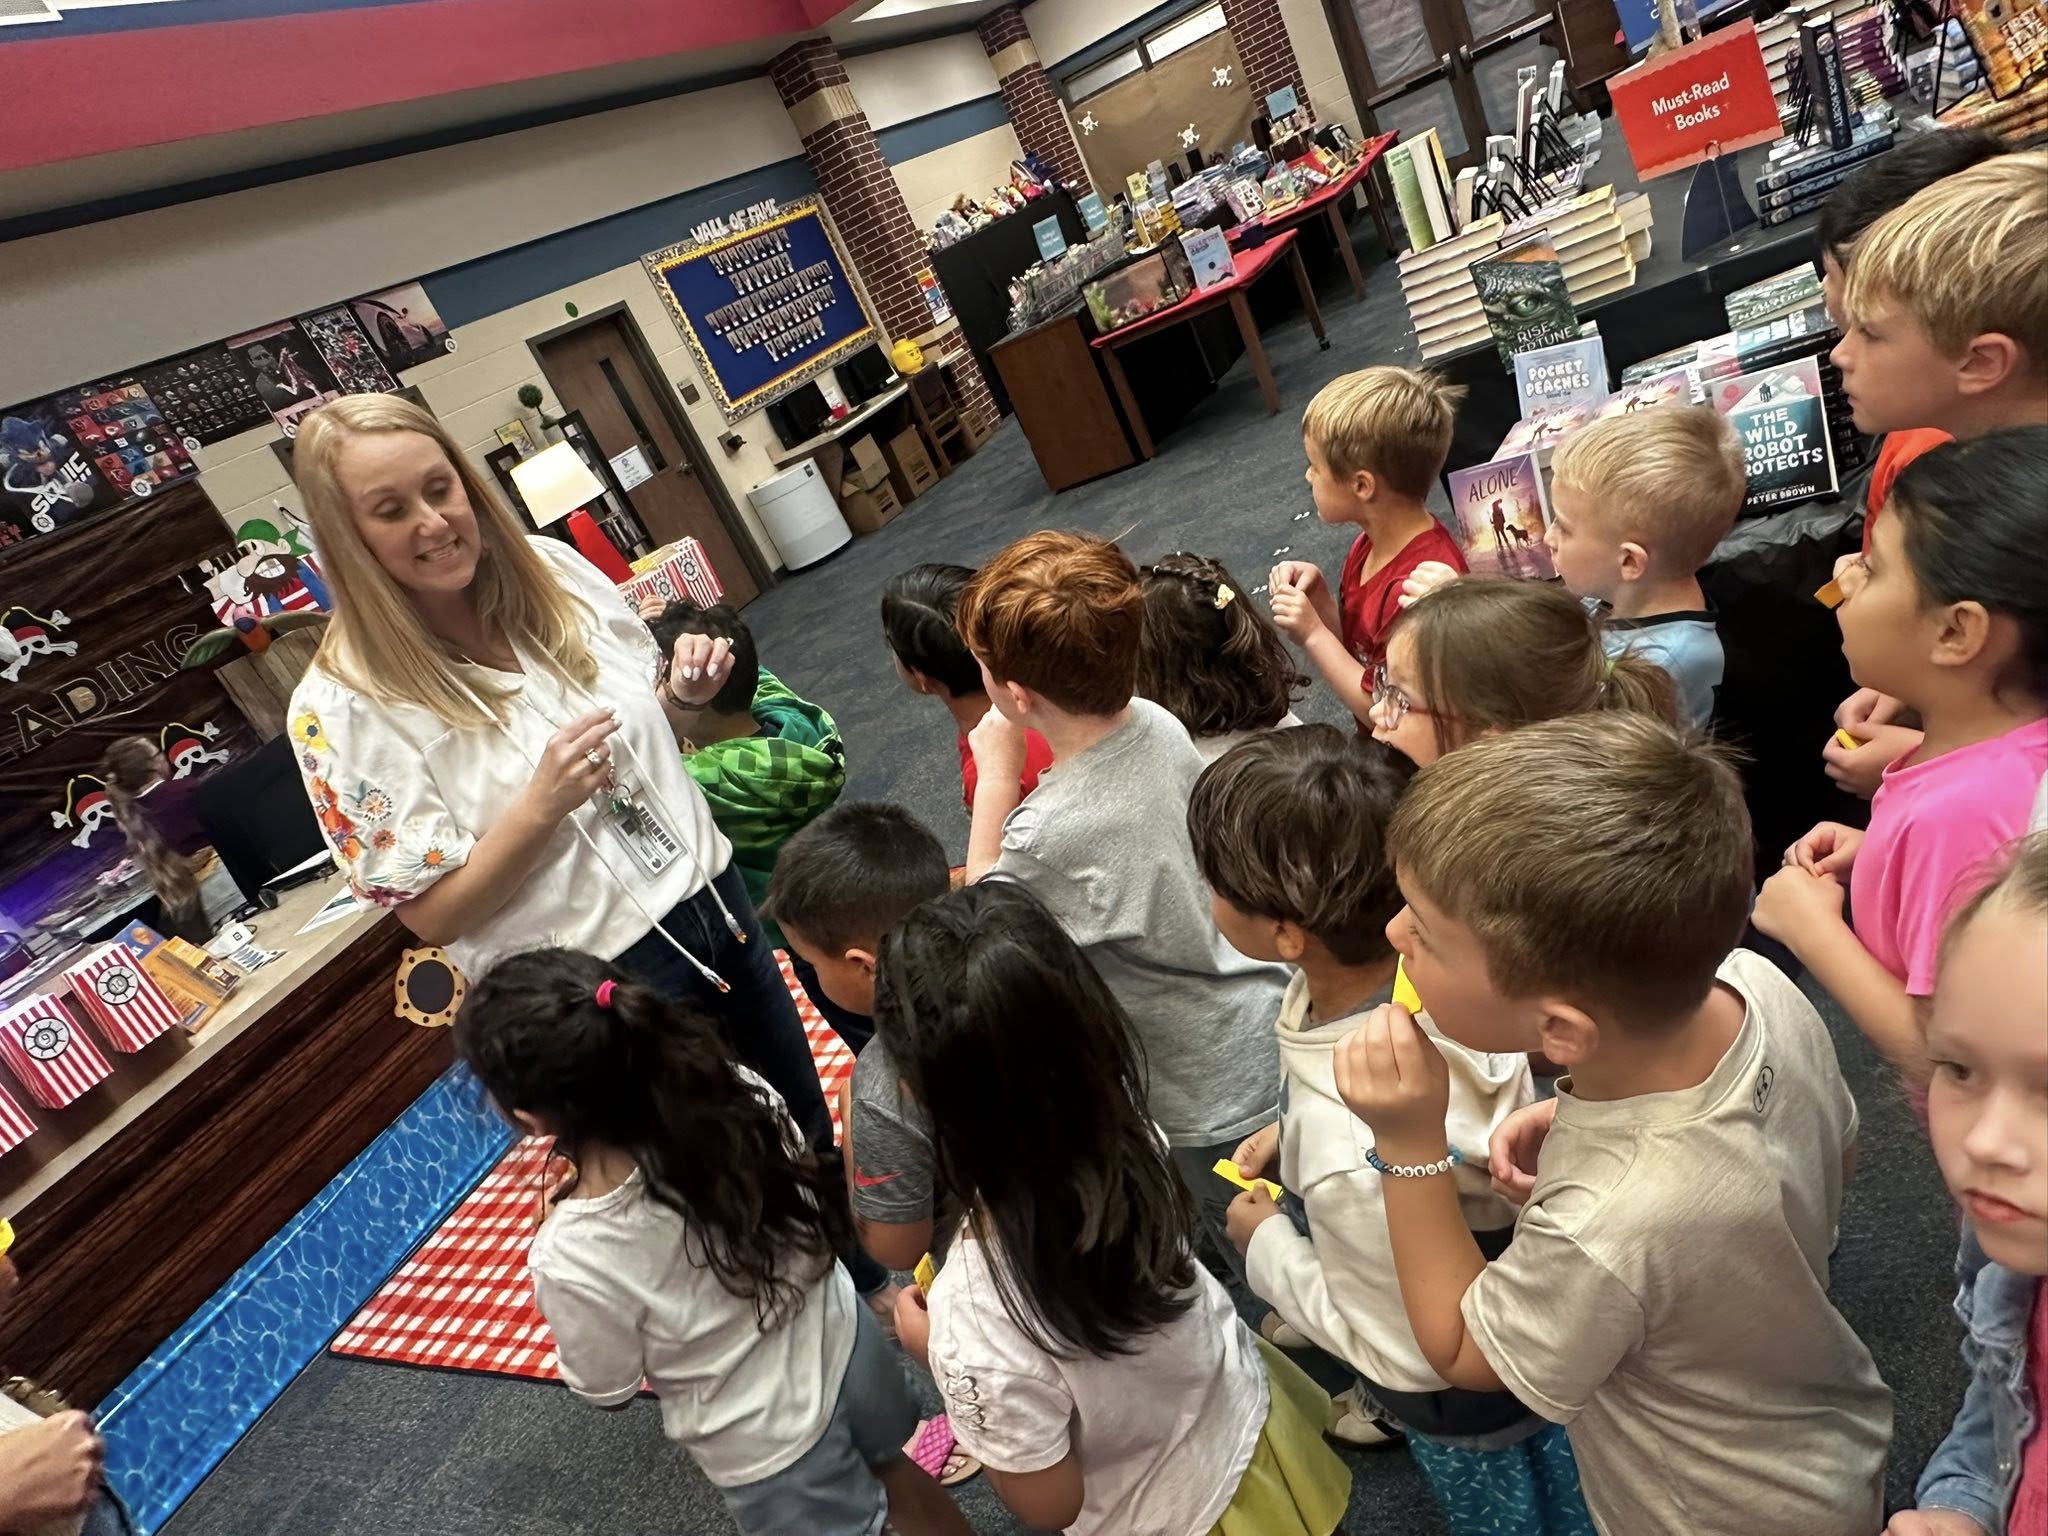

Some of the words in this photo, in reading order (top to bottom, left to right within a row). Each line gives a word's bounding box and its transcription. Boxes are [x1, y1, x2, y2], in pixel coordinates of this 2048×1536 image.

[2001, 6, 2038, 37] FIRST
[2006, 18, 2047, 52] STATE
[1651, 71, 1730, 116] Must-Read
[1674, 104, 1721, 131] Books
[690, 216, 730, 245] WALL
[729, 209, 746, 232] OF
[747, 198, 780, 225] FAME
[1516, 321, 1552, 343] RISE
[1527, 359, 1583, 382] POCKET
[1525, 373, 1591, 397] PEACHES
[1750, 407, 1789, 428] THE
[1745, 420, 1798, 444] WILD
[1744, 447, 1824, 477] ROTECTS
[1469, 466, 1519, 503] ALONE
[1746, 491, 1778, 505] PETER
[1779, 485, 1815, 500] BROWN
[0, 624, 198, 763] ADING
